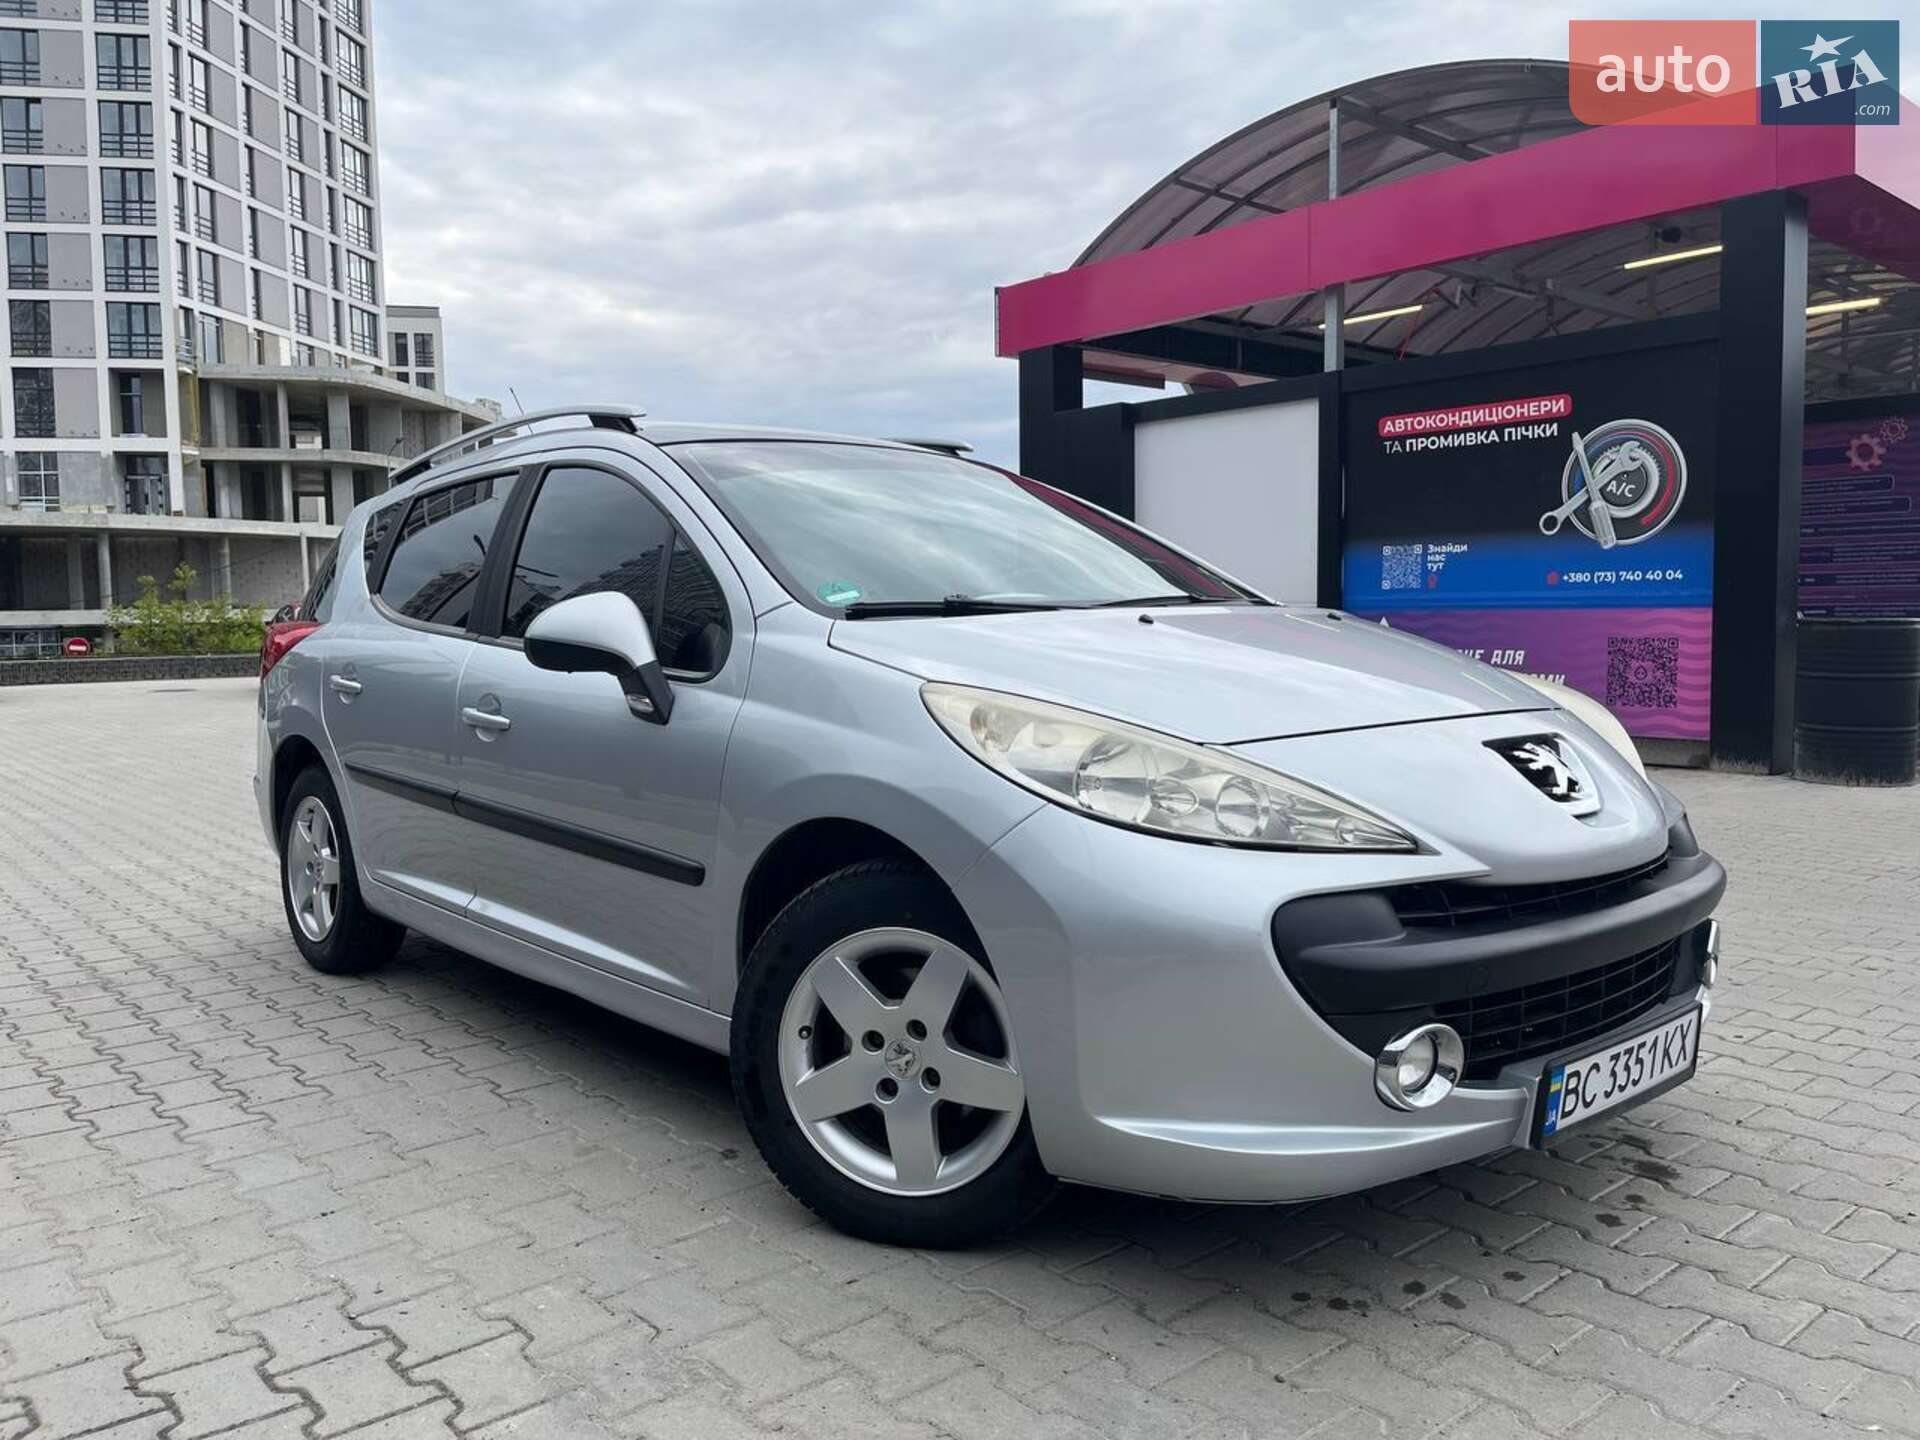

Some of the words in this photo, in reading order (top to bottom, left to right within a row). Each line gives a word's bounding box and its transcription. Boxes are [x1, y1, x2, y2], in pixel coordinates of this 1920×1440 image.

[1384, 398, 1565, 434] АВТОКОНДИЦІОНЕРИ
[1384, 440, 1402, 454] ТА
[1406, 429, 1500, 453] ПРОМИВКА
[1504, 423, 1558, 442] ПІЧКИ
[1606, 480, 1636, 497] A/C
[1427, 543, 1468, 553] Знайди
[1427, 554, 1446, 562] нас
[1427, 562, 1444, 572] тут
[1563, 572, 1591, 583] +380
[1594, 571, 1616, 584] (73)
[1619, 571, 1642, 581] 740
[1645, 570, 1662, 581] 40
[1665, 569, 1683, 580] 04
[1560, 1062, 1601, 1120] BC
[1604, 1035, 1659, 1099] 3351
[1660, 1019, 1692, 1074] KX
